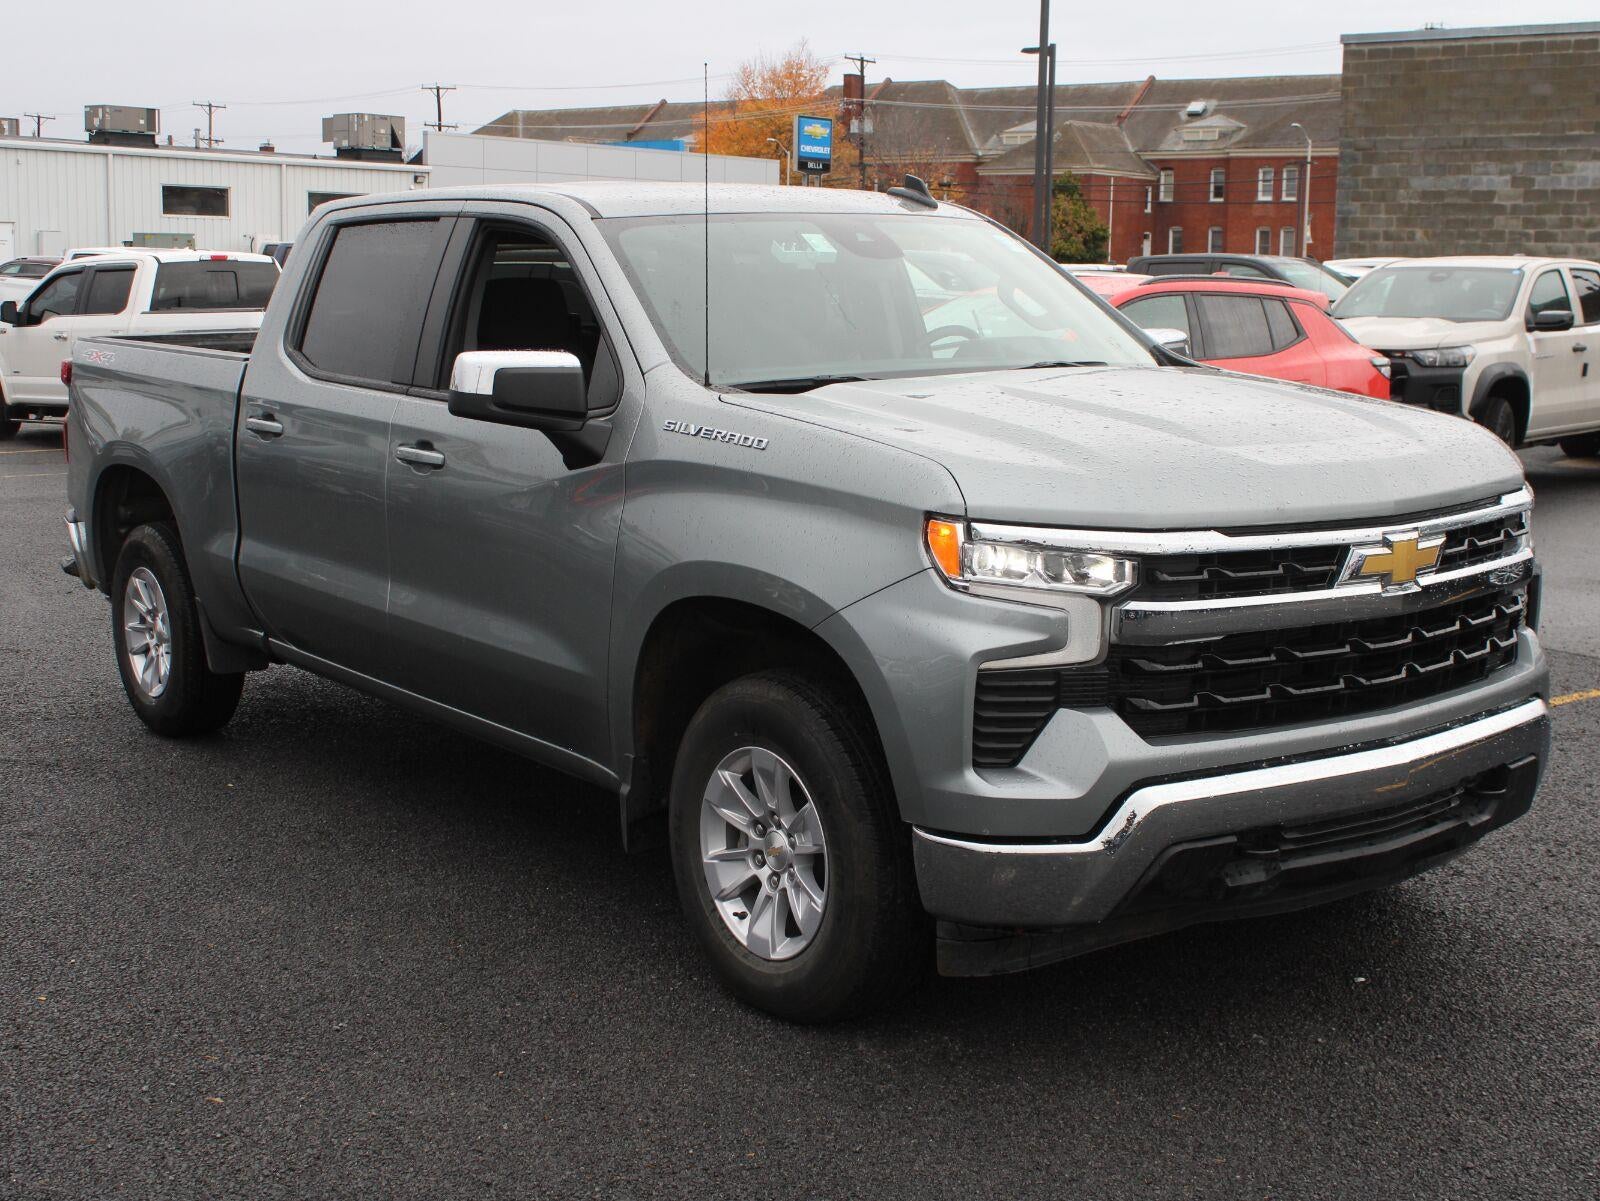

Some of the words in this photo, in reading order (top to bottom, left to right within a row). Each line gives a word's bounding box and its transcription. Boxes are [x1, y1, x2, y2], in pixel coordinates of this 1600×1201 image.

[800, 144, 831, 154] CHEVROLET
[807, 161, 823, 169] DELLA
[663, 419, 769, 450] SILVERADO
